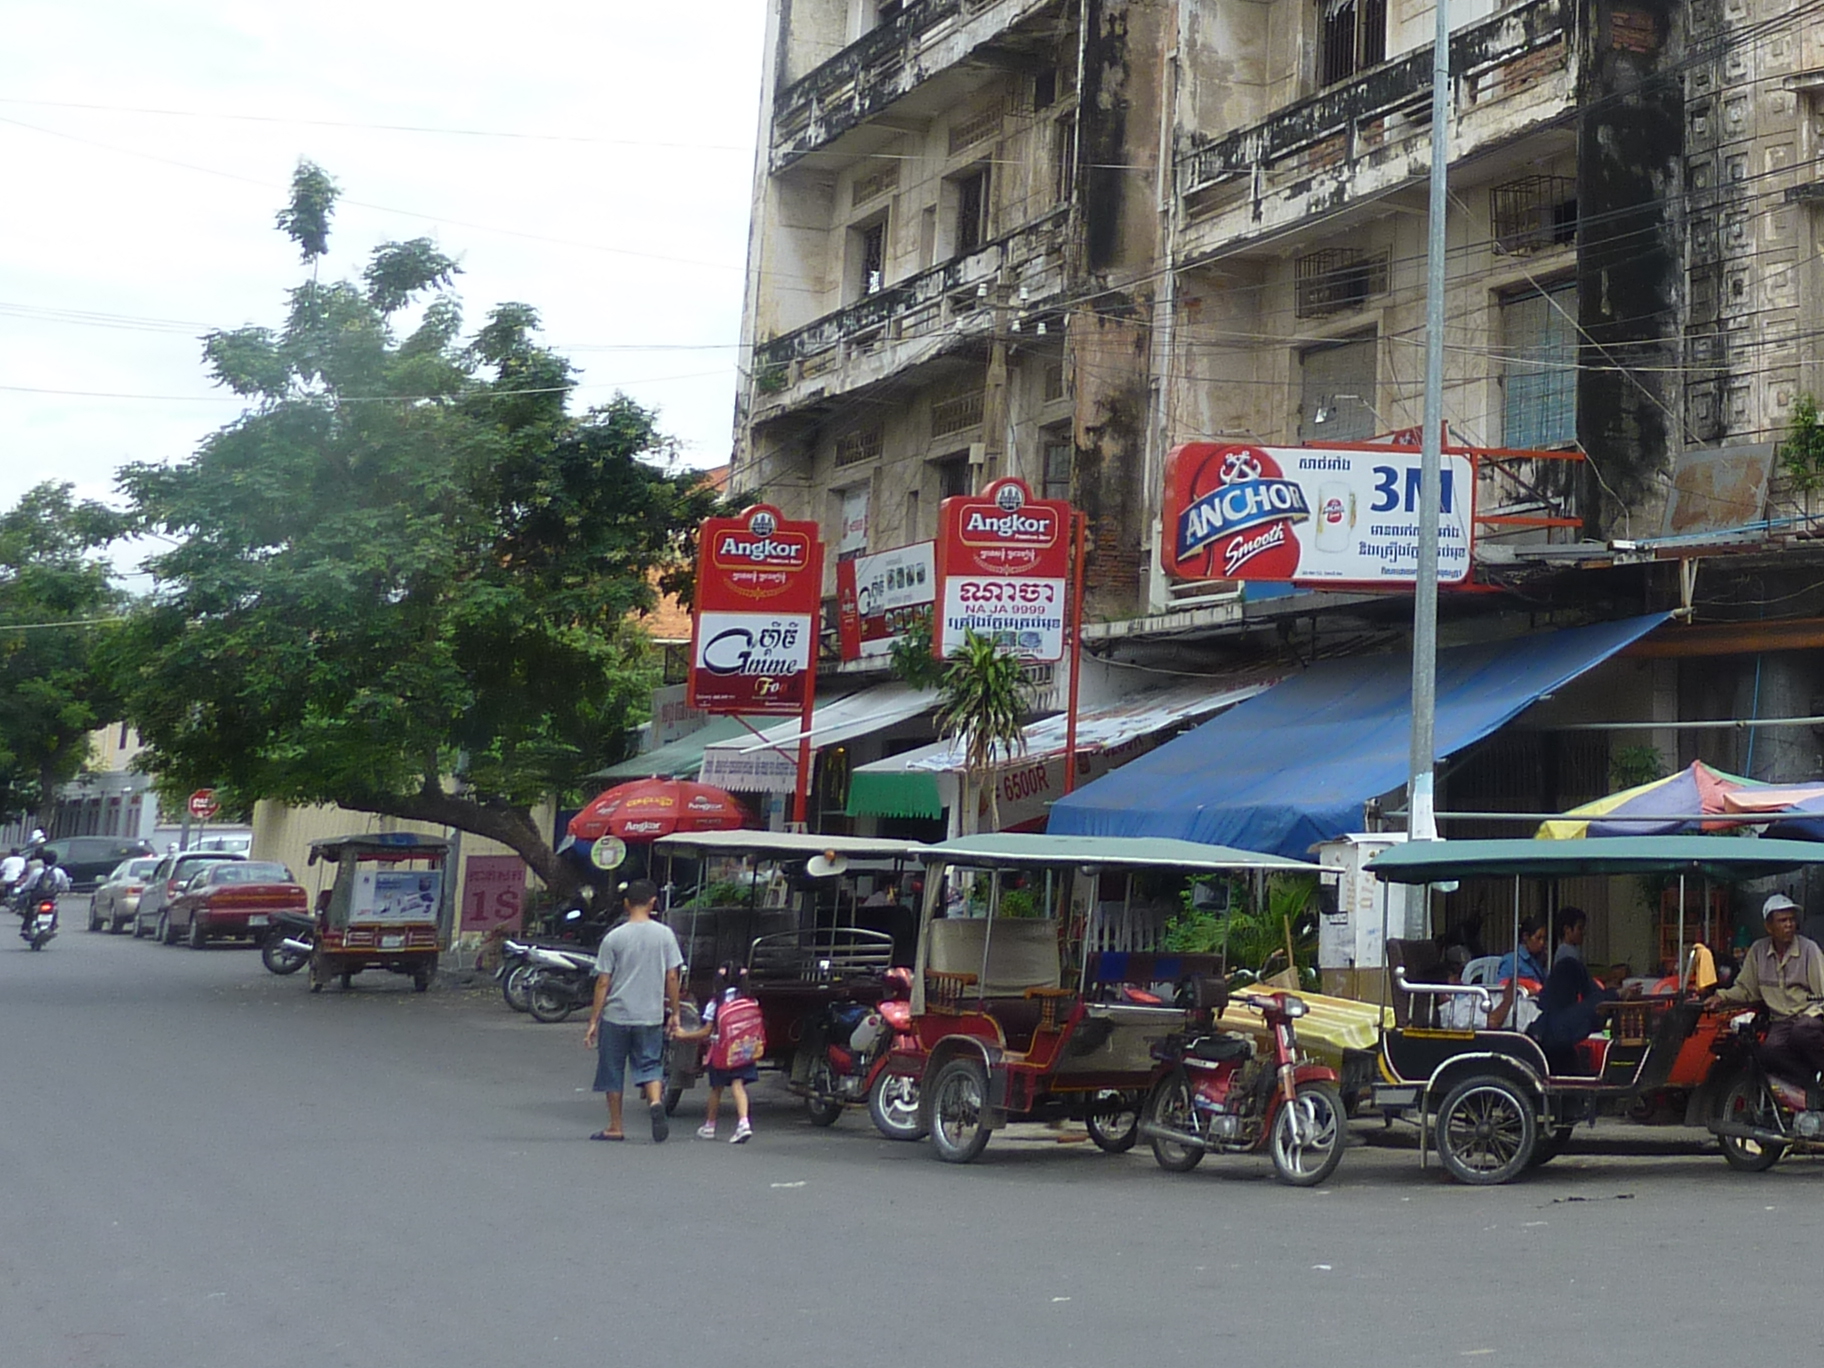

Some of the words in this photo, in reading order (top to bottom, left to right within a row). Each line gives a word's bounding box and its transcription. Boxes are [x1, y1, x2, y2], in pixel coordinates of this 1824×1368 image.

[967, 513, 1050, 537] Angkor
[1184, 483, 1308, 546] ANCHOR
[720, 537, 801, 561] Angkor
[1225, 521, 1286, 564] Smooth
[965, 604, 986, 614] NA
[990, 605, 1008, 614] JA
[1012, 605, 1046, 614] 9999
[624, 820, 662, 832] Angkor
